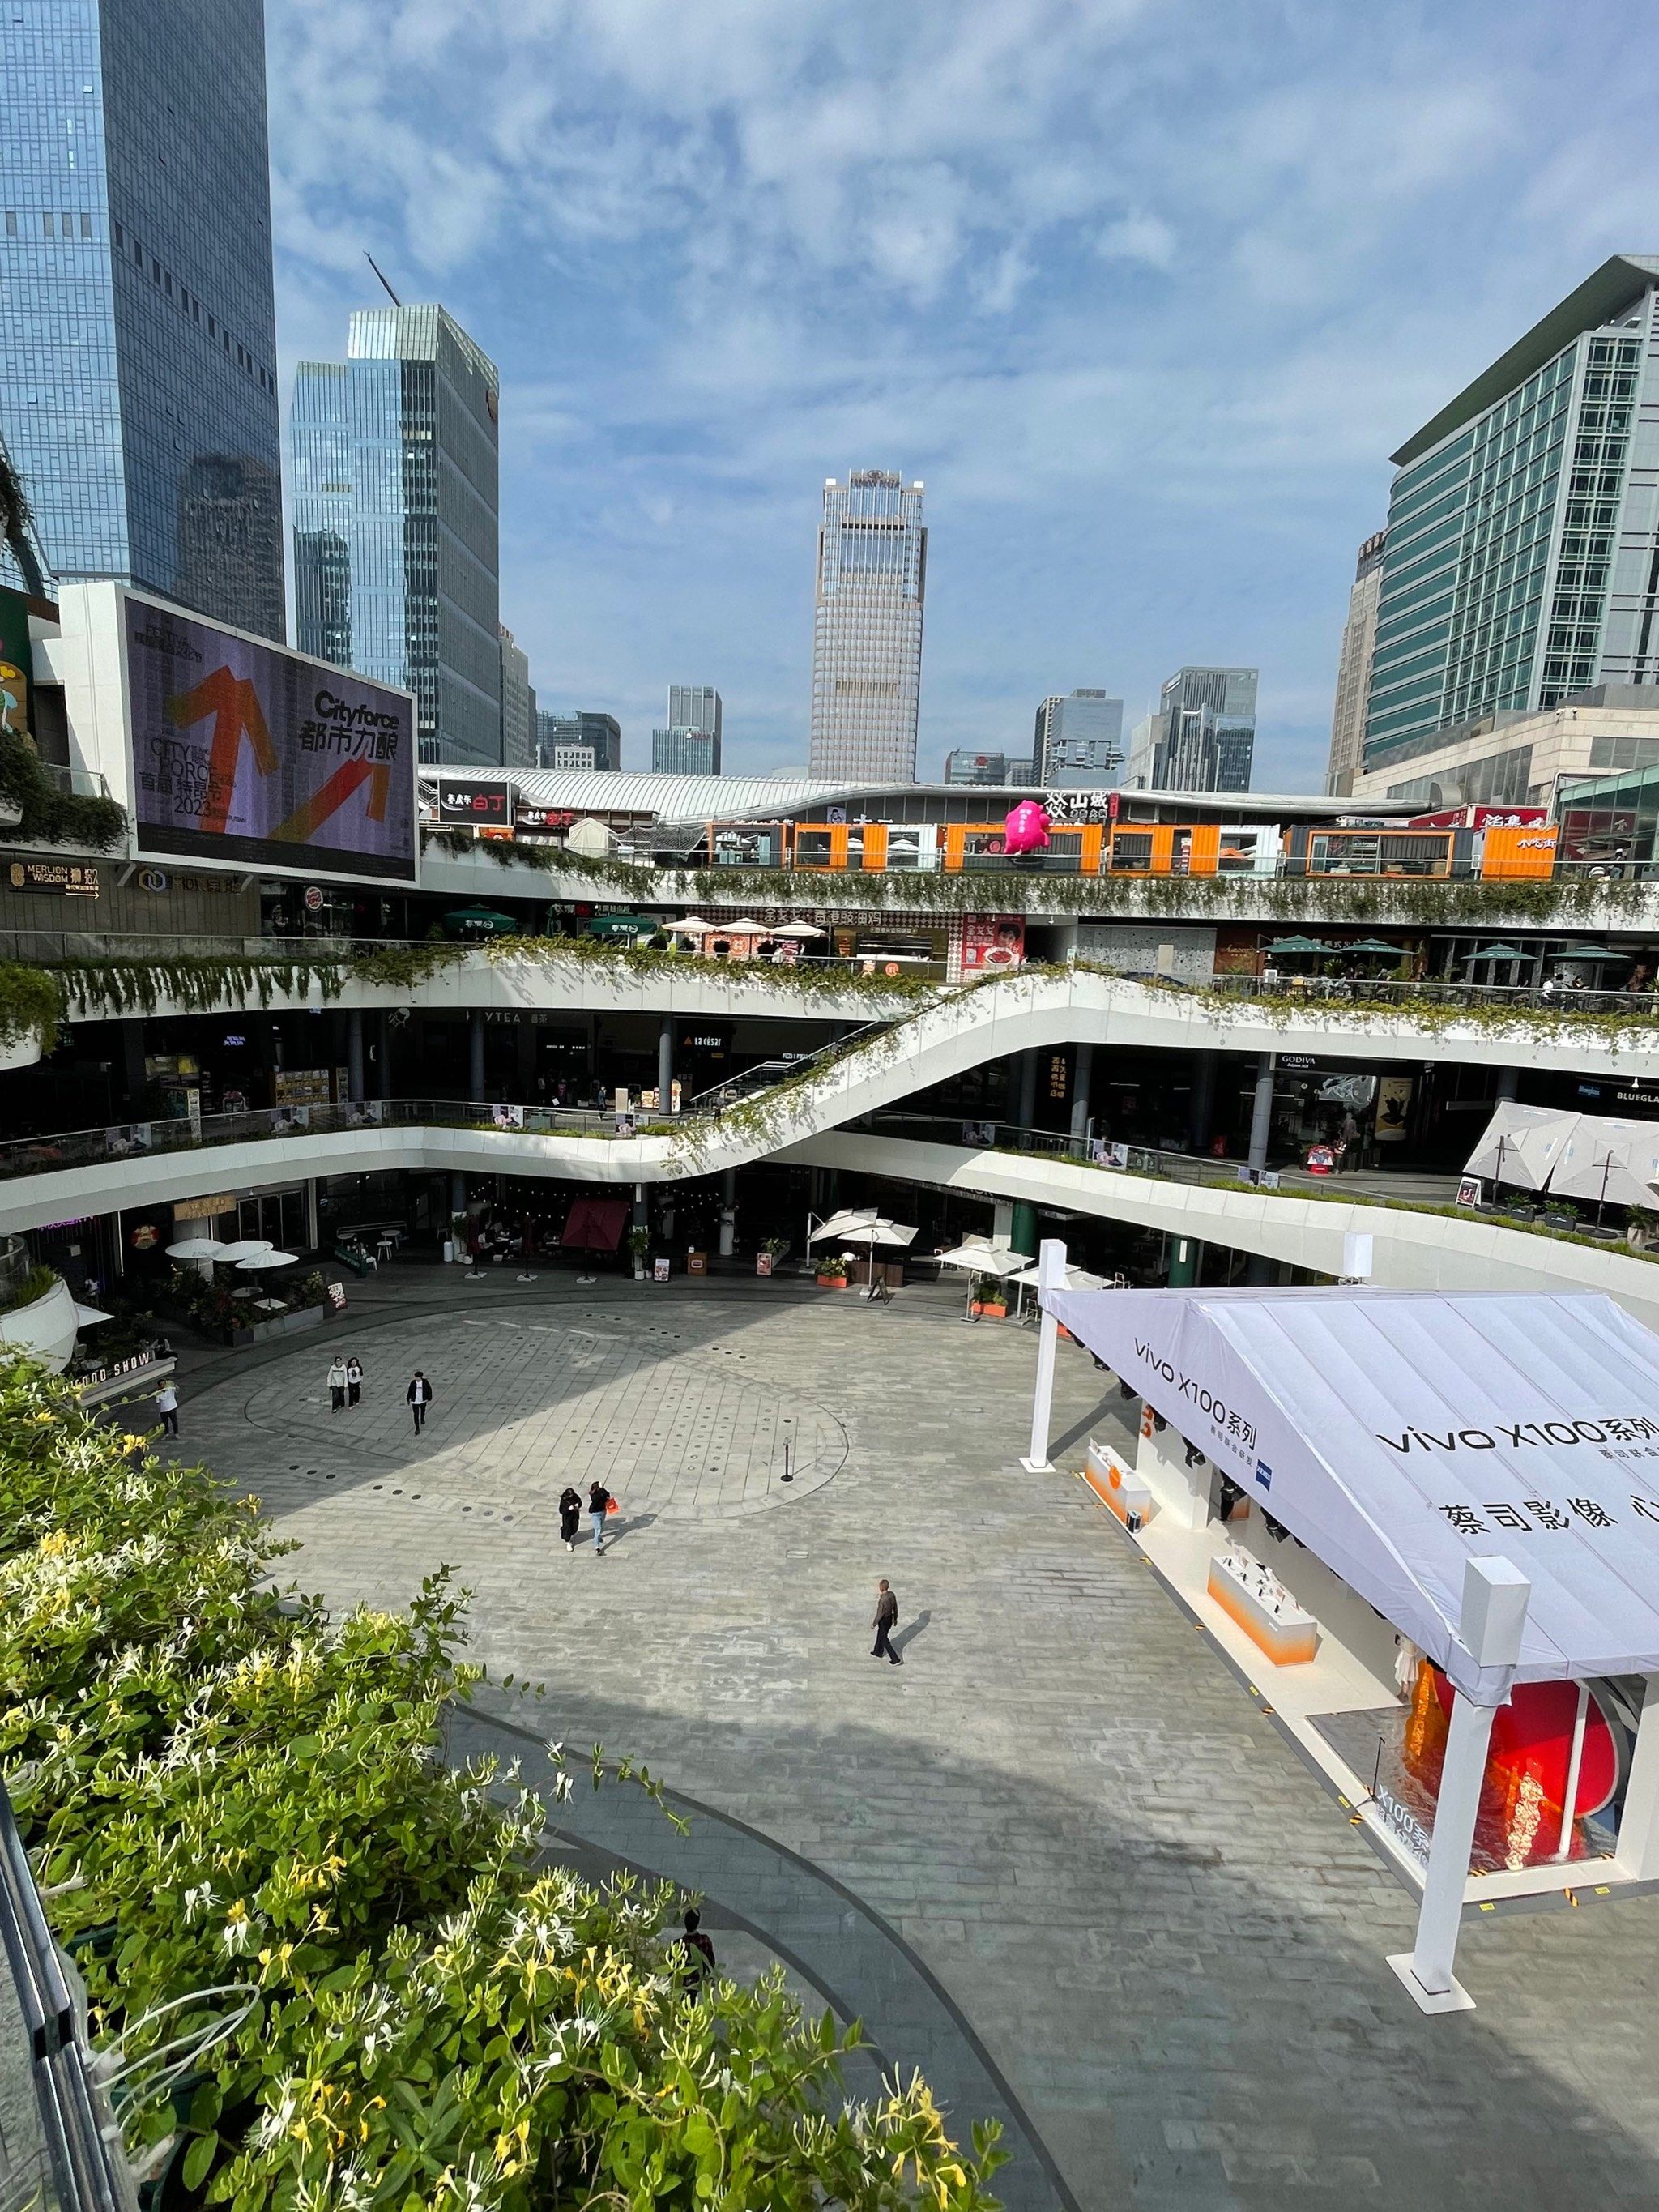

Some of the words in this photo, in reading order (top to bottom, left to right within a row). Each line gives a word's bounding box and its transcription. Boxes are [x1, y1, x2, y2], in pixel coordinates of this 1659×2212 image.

[315, 690, 399, 730] Cityforce
[151, 738, 190, 761] CITY
[299, 718, 399, 760] 都市力酿
[28, 864, 68, 874] MERLION
[33, 873, 68, 883] WISDOM
[467, 1011, 521, 1023] YTEA
[531, 1014, 548, 1023] 喜茶
[1282, 1055, 1316, 1065] GODIVA
[113, 1352, 150, 1376] SHOW
[1134, 1337, 1175, 1383] vivo
[1178, 1372, 1257, 1450] X100系列
[1375, 1425, 1496, 1453] vivo
[1494, 1416, 1659, 1448] X100系列
[1598, 1446, 1659, 1459] 蔡司联合
[1439, 1497, 1618, 1535] 蔡司影像
[1377, 1783, 1430, 1853] X100系
